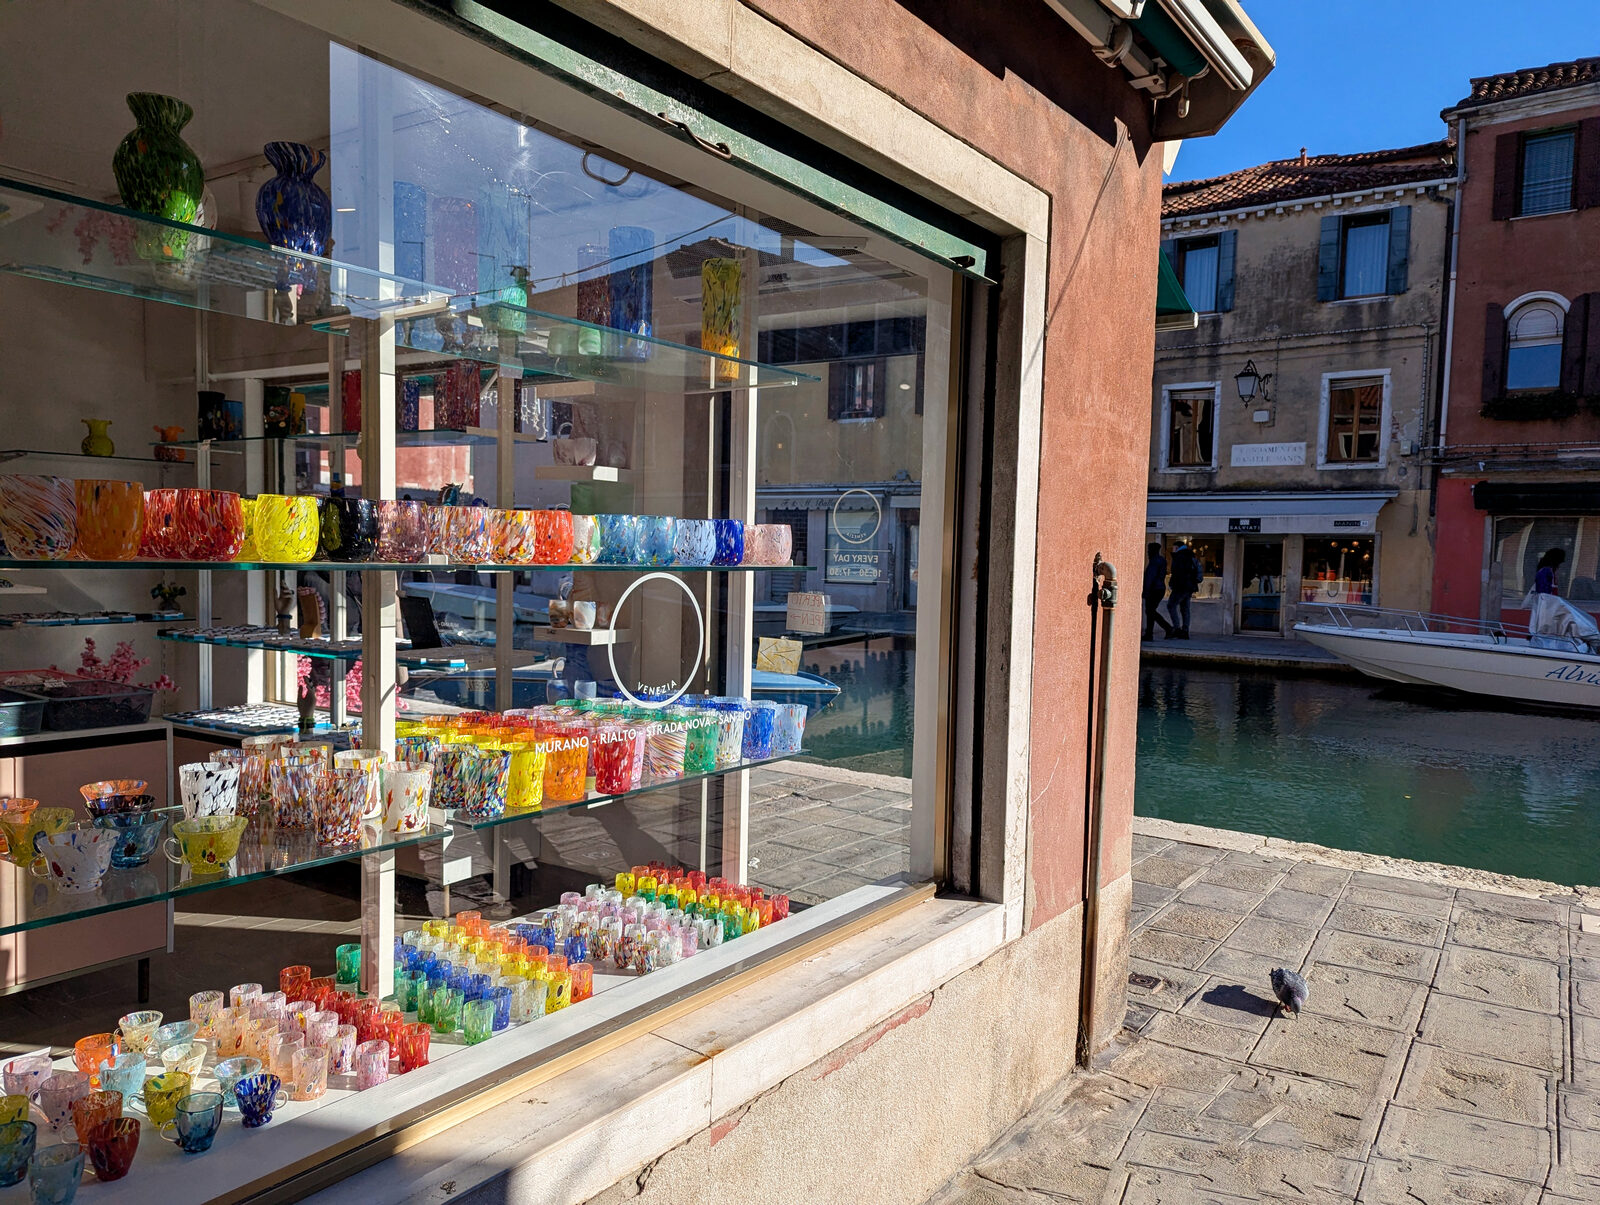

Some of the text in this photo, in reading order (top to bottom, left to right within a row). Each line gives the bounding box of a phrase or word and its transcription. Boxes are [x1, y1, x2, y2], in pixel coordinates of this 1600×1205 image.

[637, 679, 677, 695] VENEZIA
[535, 735, 589, 754] MURANO
[600, 728, 636, 744] RIALTO
[646, 721, 684, 738] STRADA
[685, 717, 711, 730] NOVA
[719, 712, 736, 725] SAN
